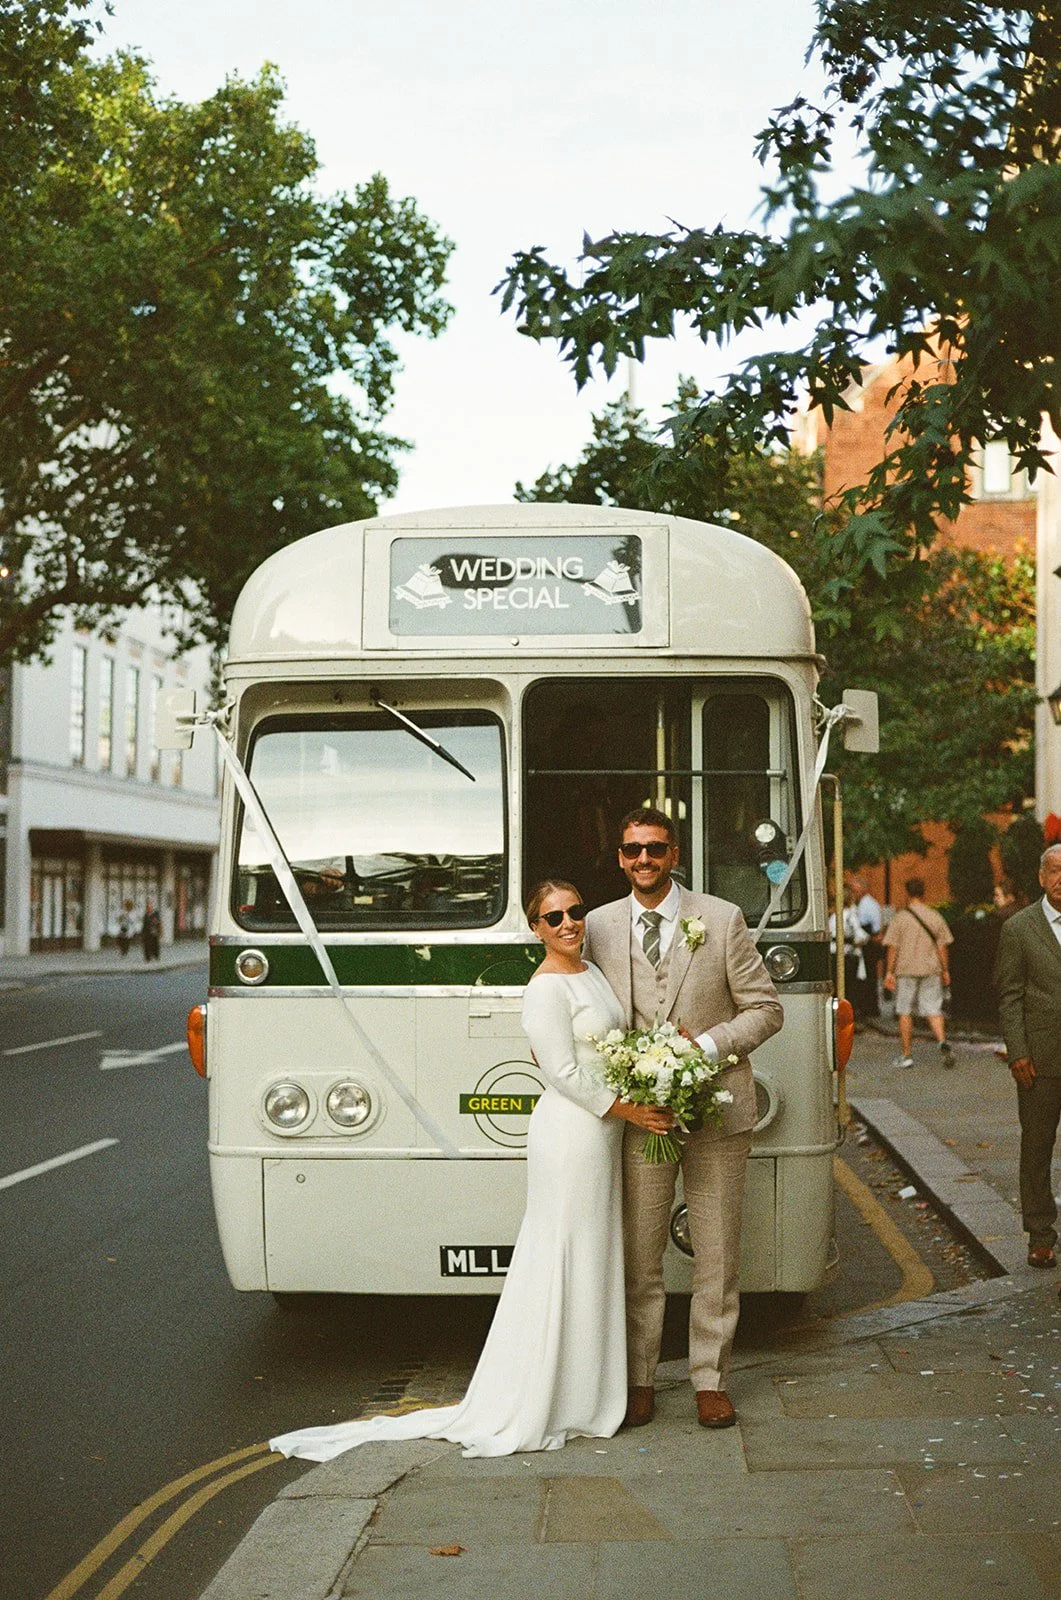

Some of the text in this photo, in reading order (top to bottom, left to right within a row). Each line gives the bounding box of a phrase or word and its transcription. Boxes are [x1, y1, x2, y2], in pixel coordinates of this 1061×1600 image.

[450, 557, 584, 582] WEDDING
[463, 587, 570, 610] SPECIAL
[468, 1097, 522, 1110] GREEN
